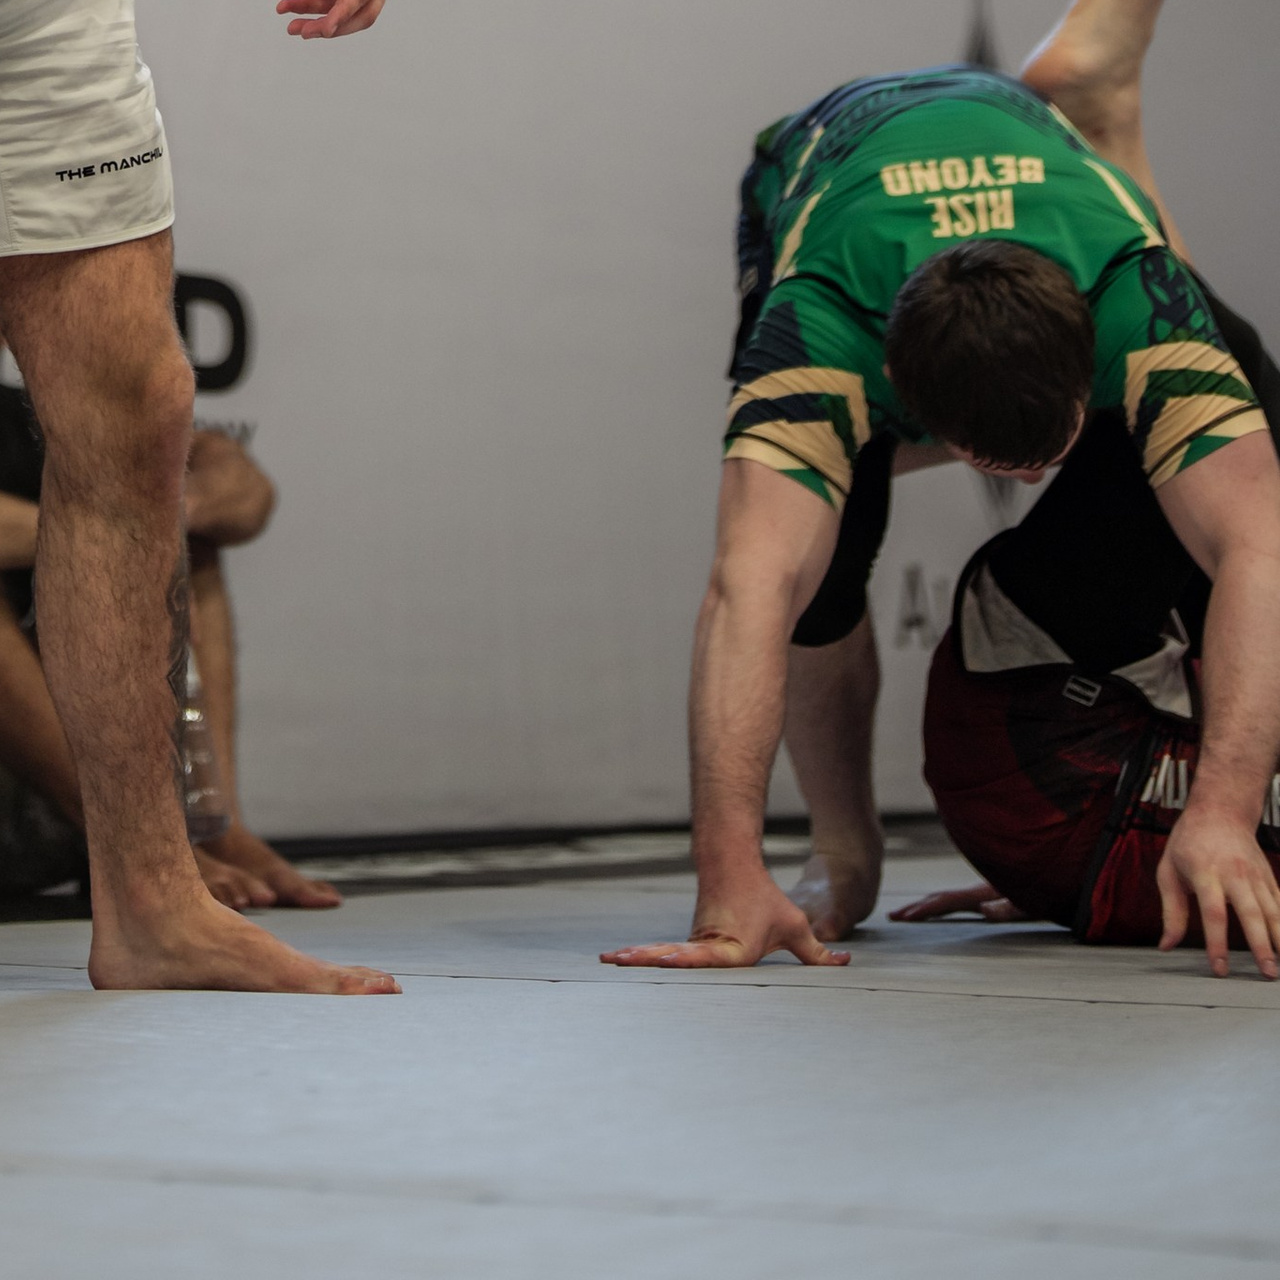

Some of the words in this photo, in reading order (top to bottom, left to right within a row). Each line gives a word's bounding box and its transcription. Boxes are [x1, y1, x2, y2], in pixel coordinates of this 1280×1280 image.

[55, 164, 96, 182] THE
[880, 154, 1046, 197] BEYOND
[923, 188, 1015, 239] RISE
